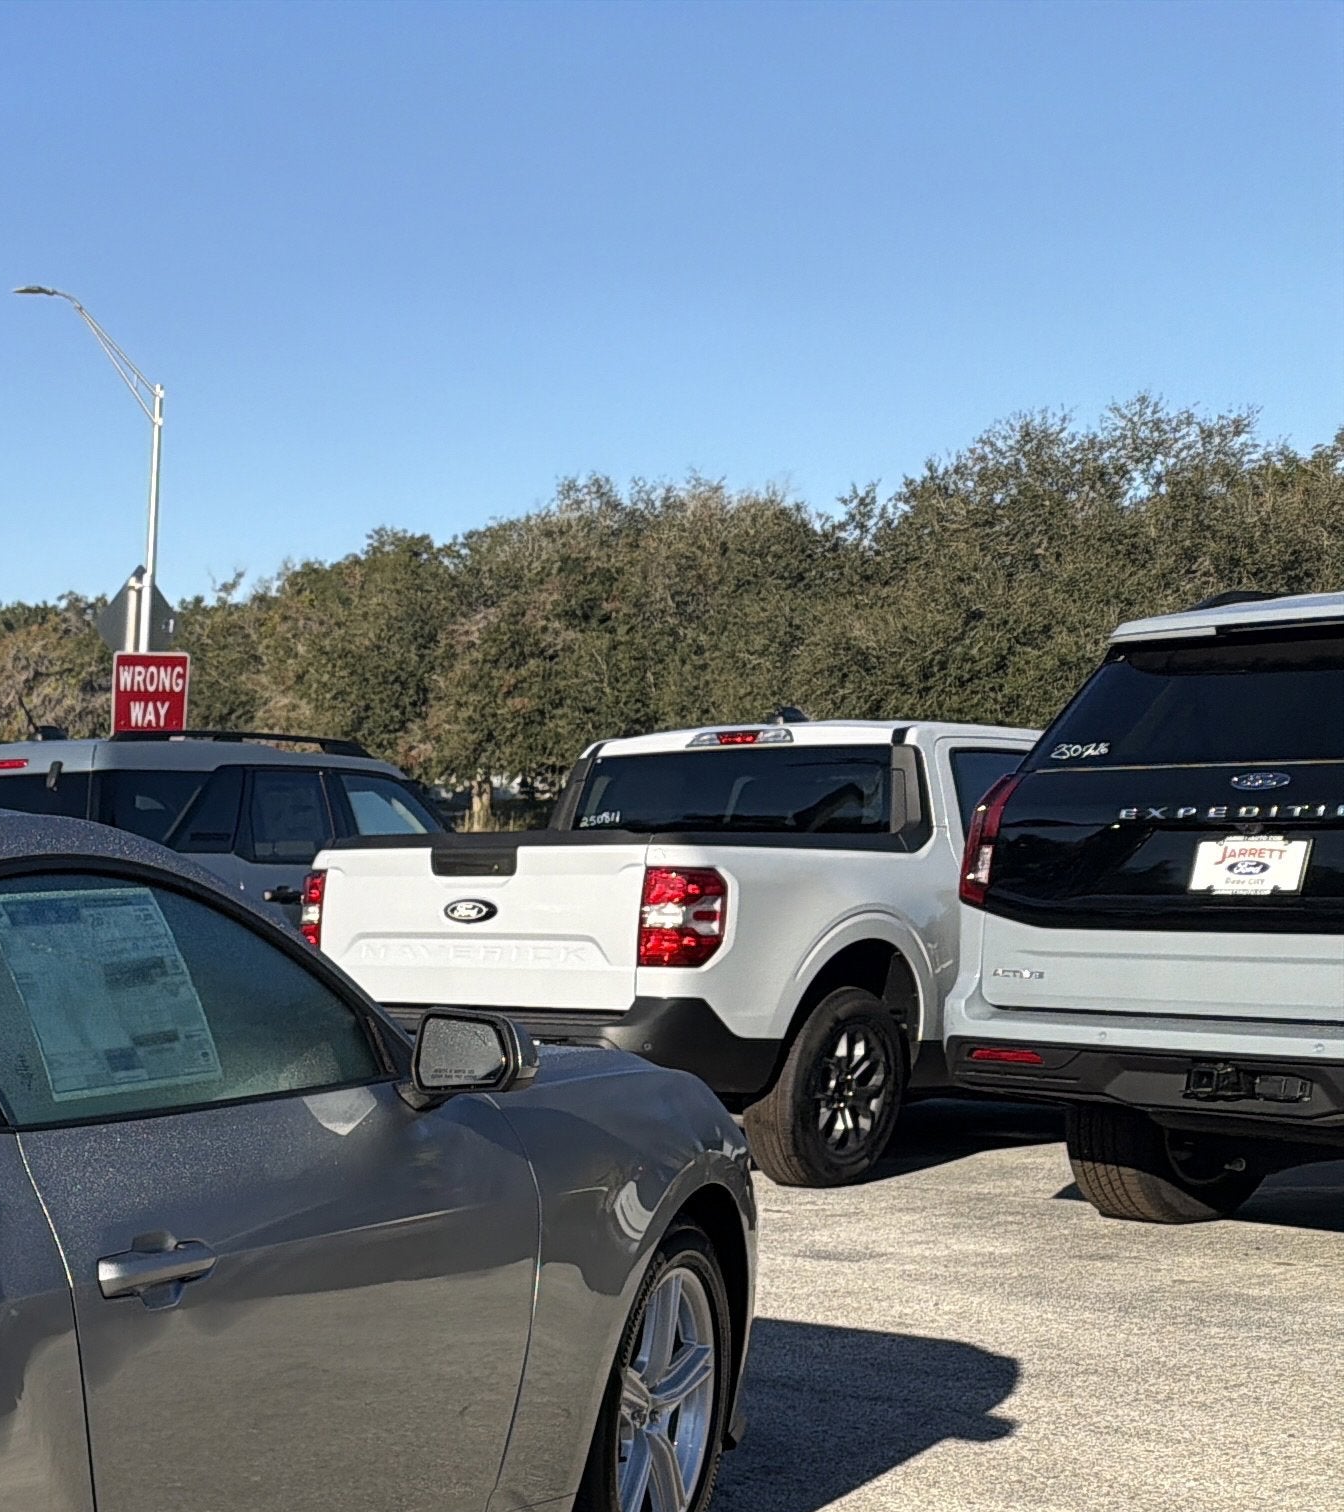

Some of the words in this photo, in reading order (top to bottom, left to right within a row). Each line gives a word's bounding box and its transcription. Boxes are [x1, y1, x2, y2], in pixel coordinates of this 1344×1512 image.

[118, 665, 184, 692] WRONG
[130, 701, 170, 727] WAY
[1214, 846, 1288, 865] JARRETT
[1233, 861, 1263, 874] Ford
[360, 942, 588, 964] MAVERICK
